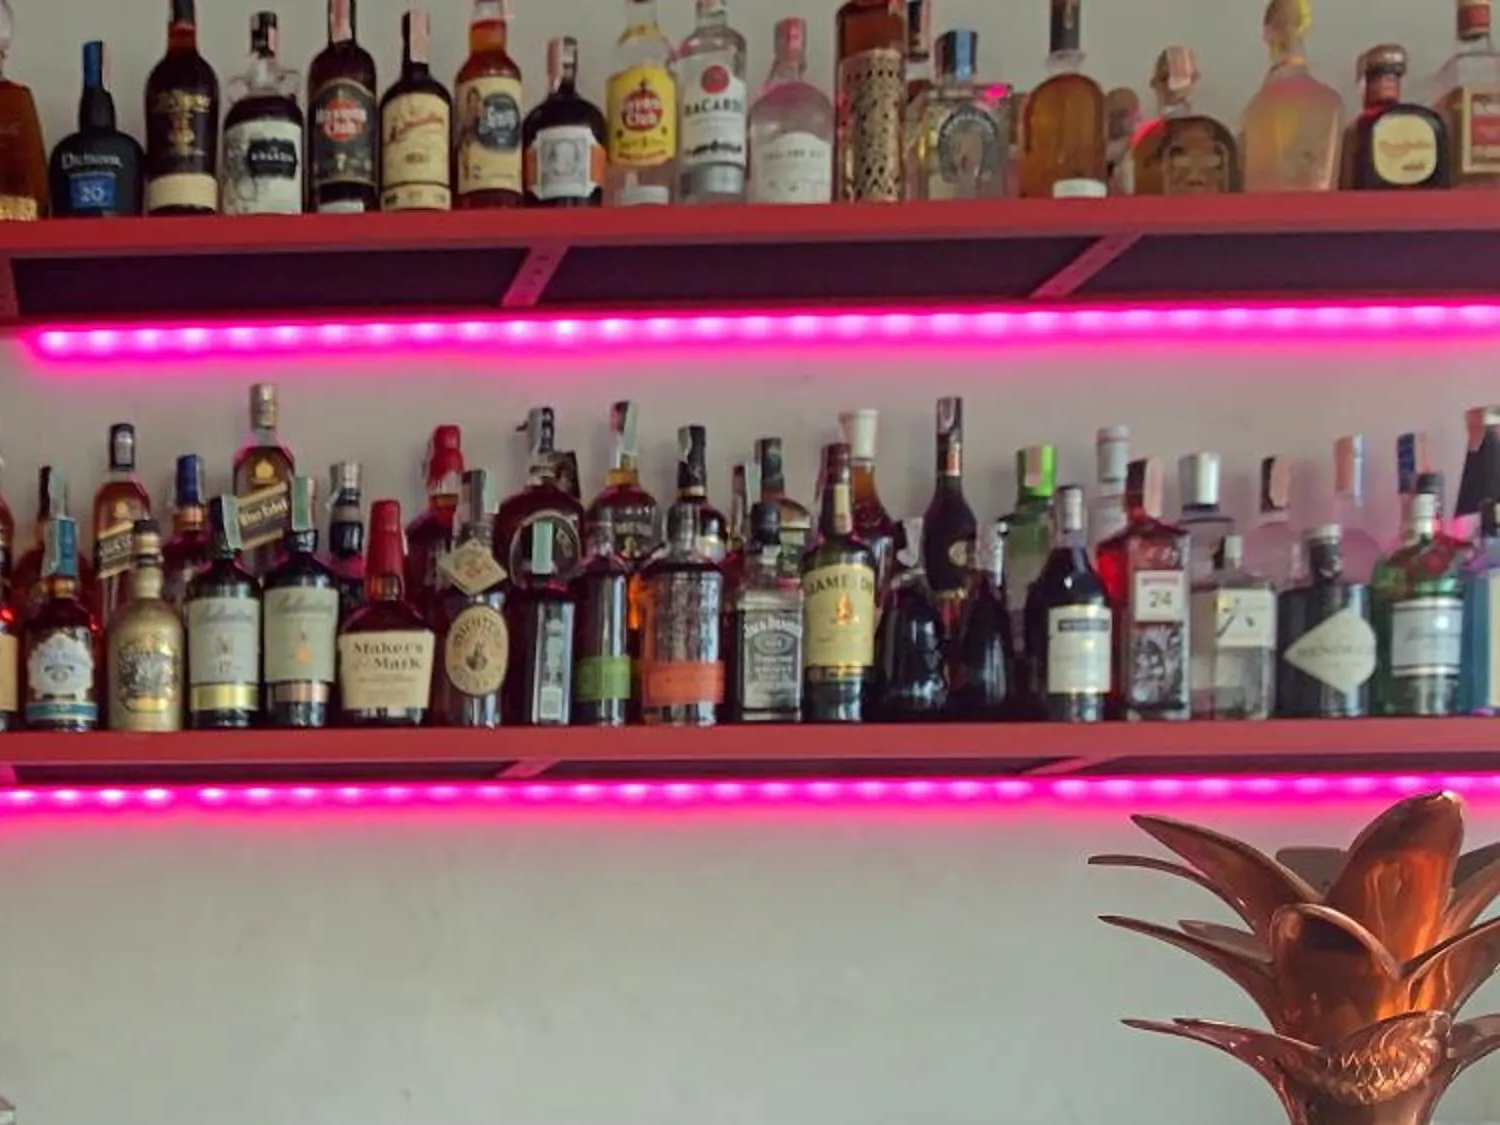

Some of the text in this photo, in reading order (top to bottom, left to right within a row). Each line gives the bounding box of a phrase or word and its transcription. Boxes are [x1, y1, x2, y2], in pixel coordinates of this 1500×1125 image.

[1149, 590, 1173, 608] 24
[353, 641, 424, 654] Maker's
[373, 659, 422, 671] Mark
